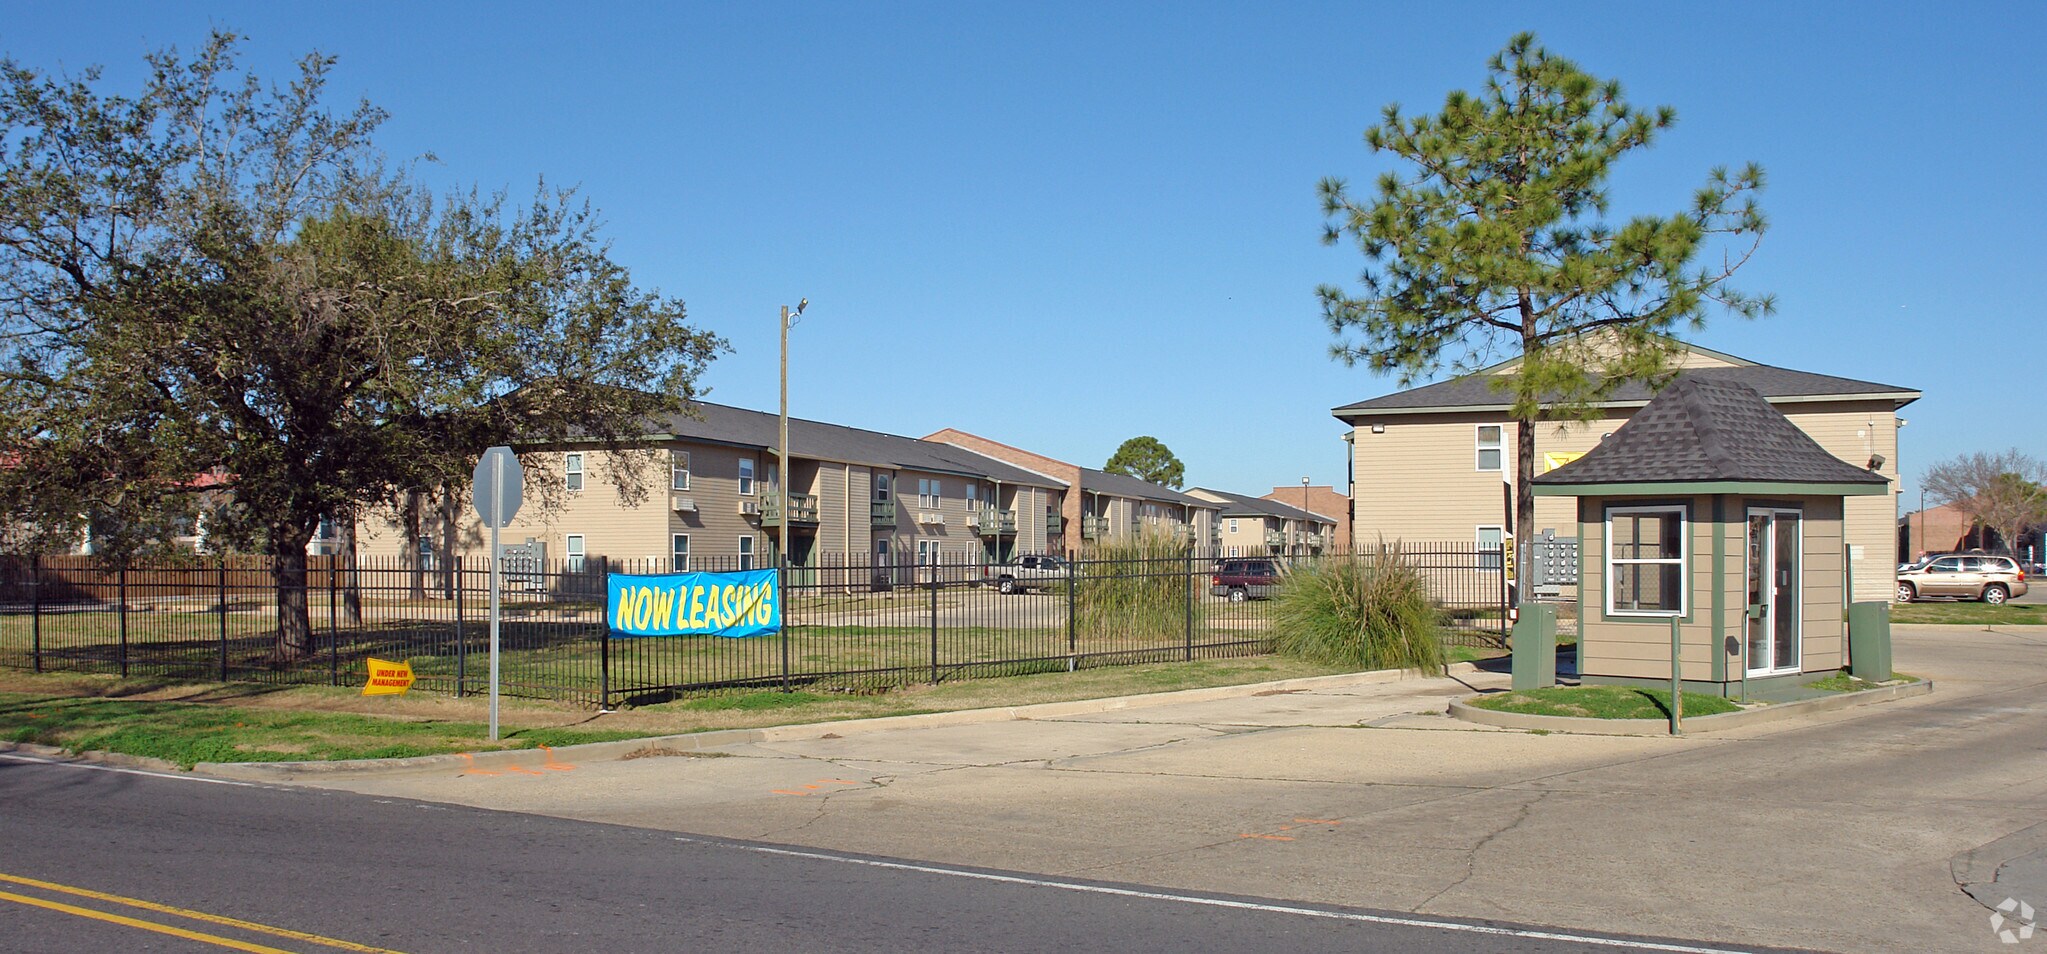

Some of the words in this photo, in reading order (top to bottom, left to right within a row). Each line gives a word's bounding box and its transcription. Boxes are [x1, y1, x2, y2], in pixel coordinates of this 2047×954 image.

[617, 586, 676, 631] NOW
[677, 581, 772, 630] LEASING
[376, 669, 396, 678] UNDER
[397, 670, 408, 678] NEW
[372, 678, 410, 687] MANAGEMENT
